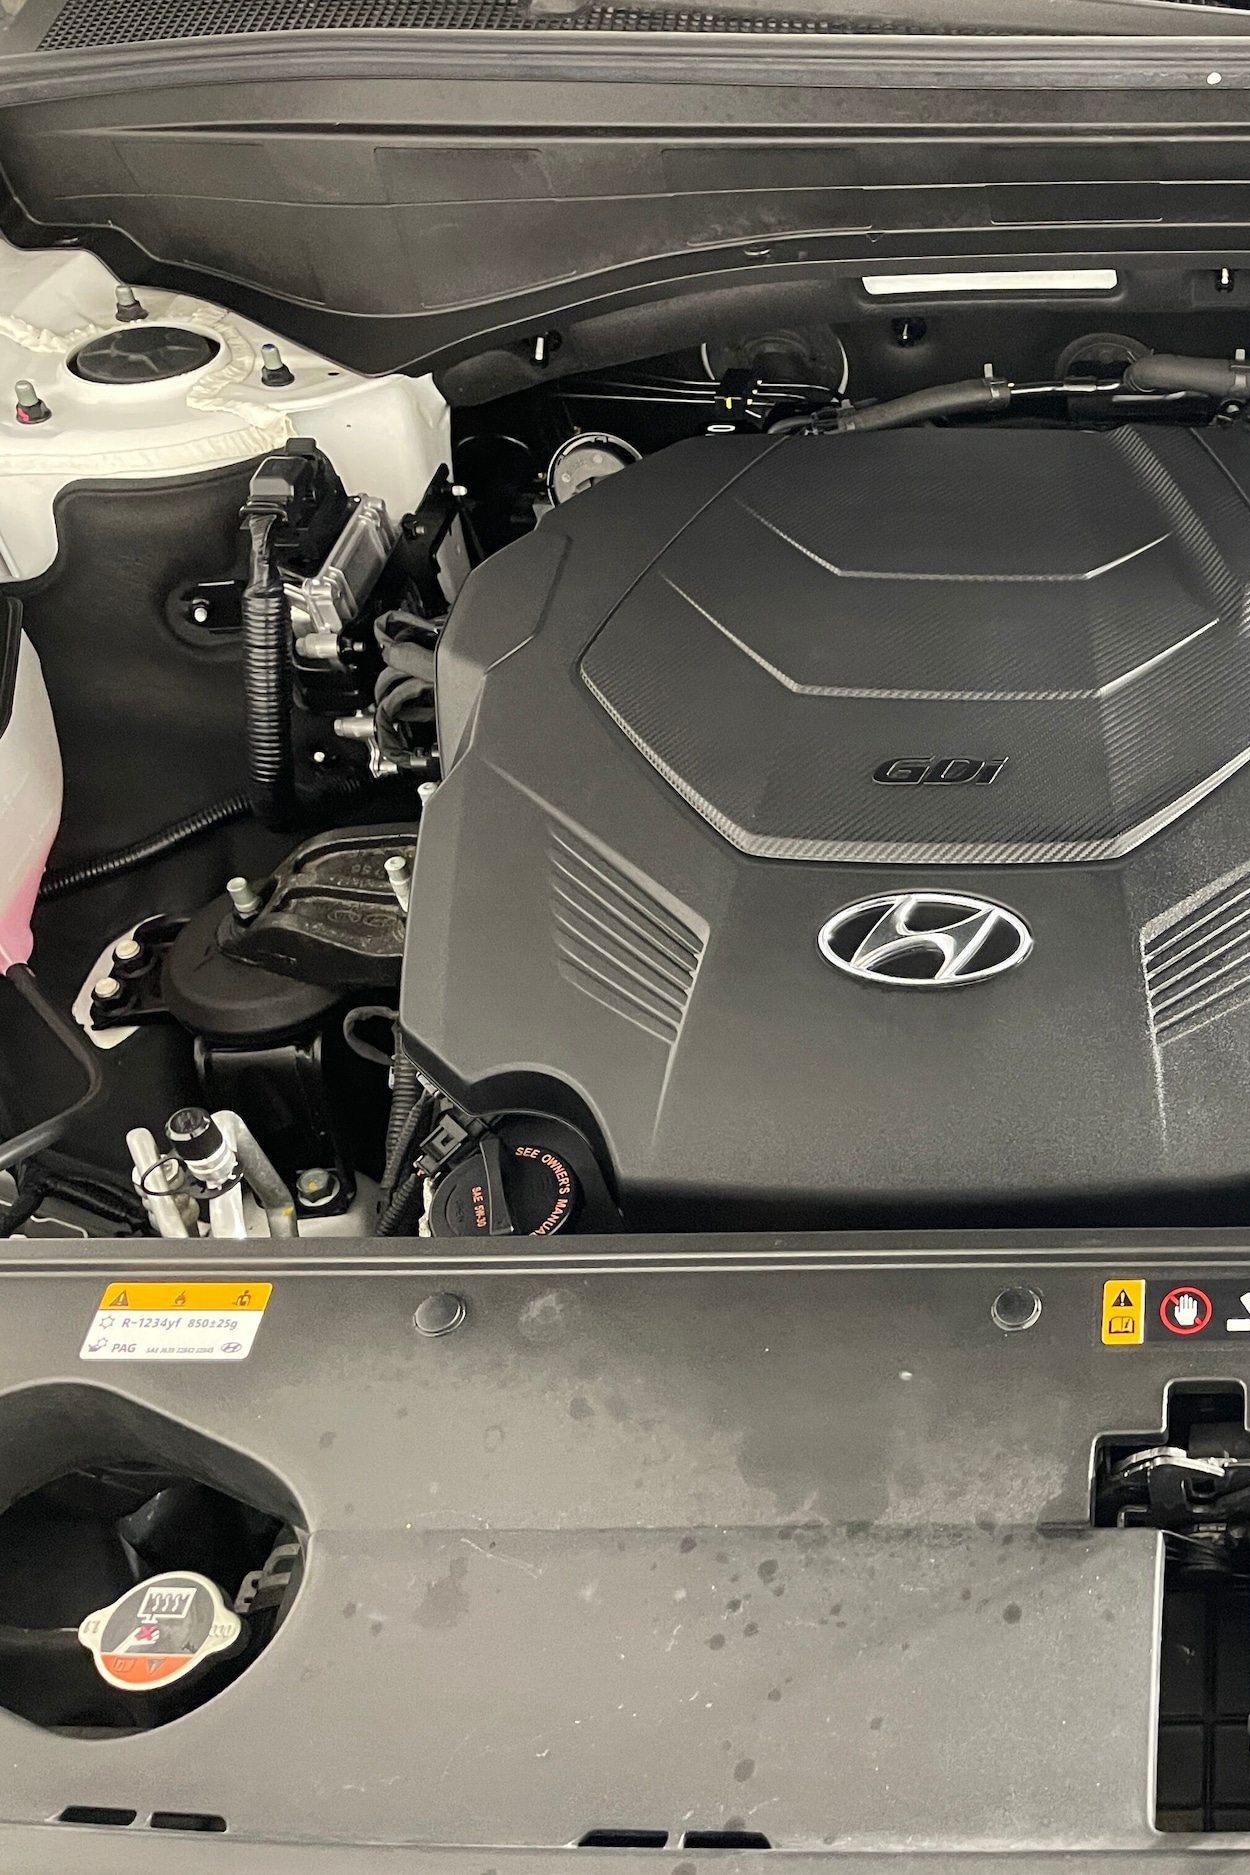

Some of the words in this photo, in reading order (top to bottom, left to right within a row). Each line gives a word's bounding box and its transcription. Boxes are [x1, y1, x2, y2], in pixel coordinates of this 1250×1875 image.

[515, 1146, 541, 1160] SEE
[540, 1153, 571, 1195] OWNER'S
[471, 1186, 483, 1203] SAE
[121, 1317, 183, 1330] R-1234yf
[187, 1318, 238, 1331] 850±25g
[111, 1343, 137, 1353] PAG
